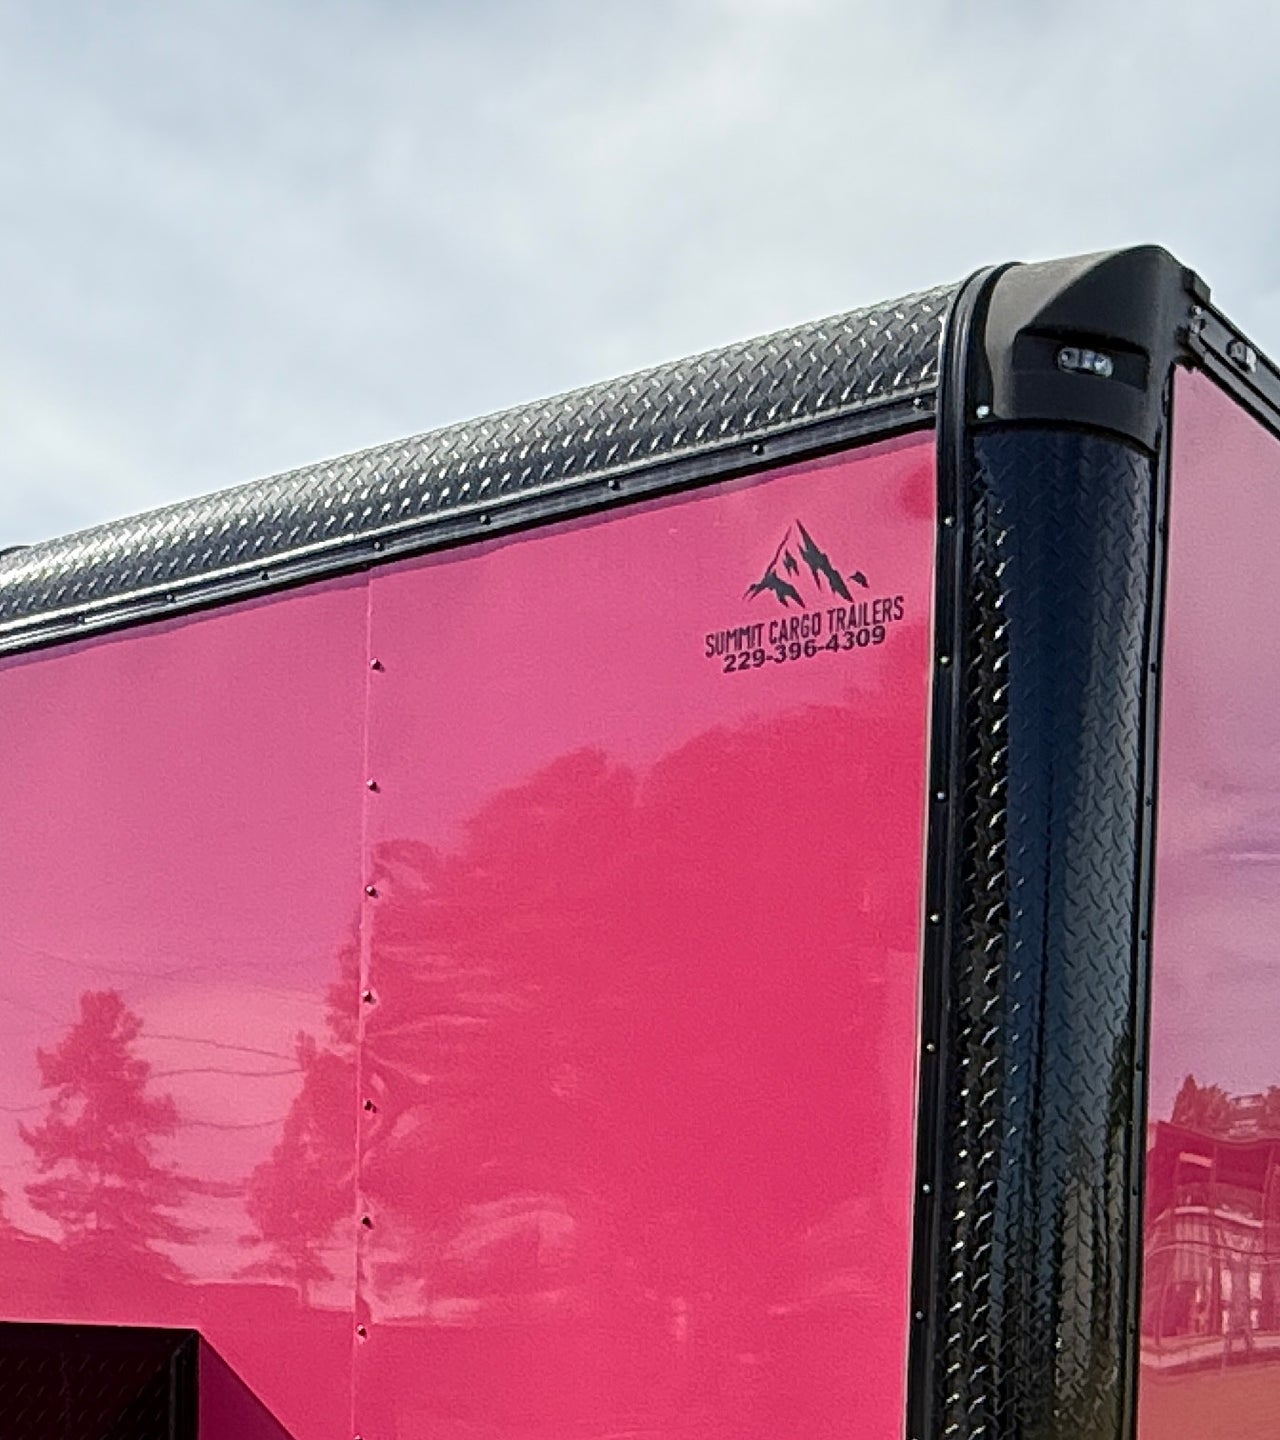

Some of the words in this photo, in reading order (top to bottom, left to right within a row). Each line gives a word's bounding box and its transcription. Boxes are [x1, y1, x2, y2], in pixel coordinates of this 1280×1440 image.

[705, 623, 764, 658] SUMMIT
[769, 612, 821, 645] CARGO
[827, 595, 905, 634] TRAILERS
[723, 625, 886, 673] 229-396-4309
